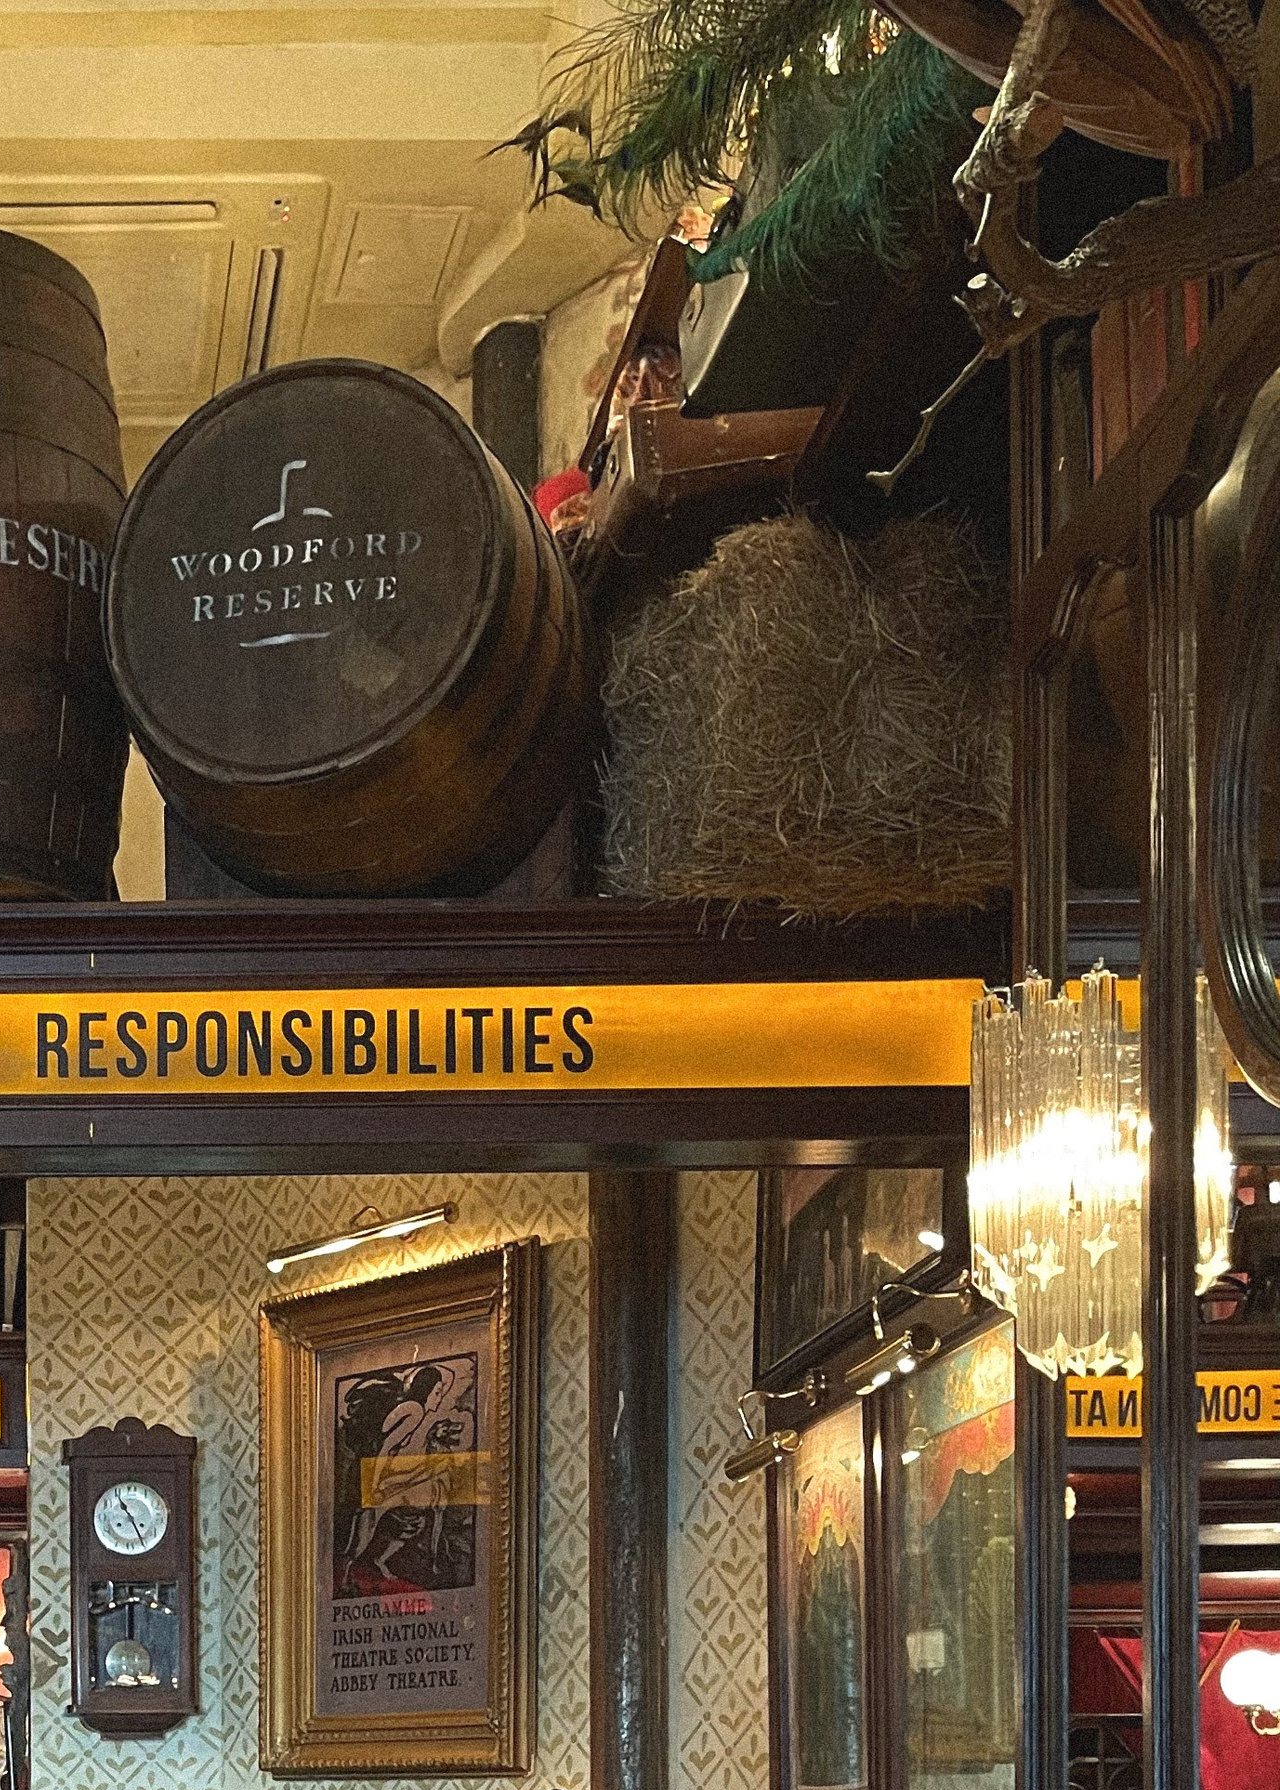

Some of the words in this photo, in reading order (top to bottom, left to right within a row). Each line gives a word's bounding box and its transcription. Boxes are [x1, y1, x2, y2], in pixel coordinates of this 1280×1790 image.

[171, 531, 422, 580] WOODFORD
[192, 576, 398, 622] RESERVE
[36, 1006, 595, 1078] RESPONSIBILITIES
[332, 1599, 426, 1623] PROGRAMME
[332, 1627, 373, 1646] IRISH
[381, 1620, 459, 1643] NATIONAL
[331, 1649, 398, 1669] THEATRE
[330, 1673, 378, 1693] ABBEY
